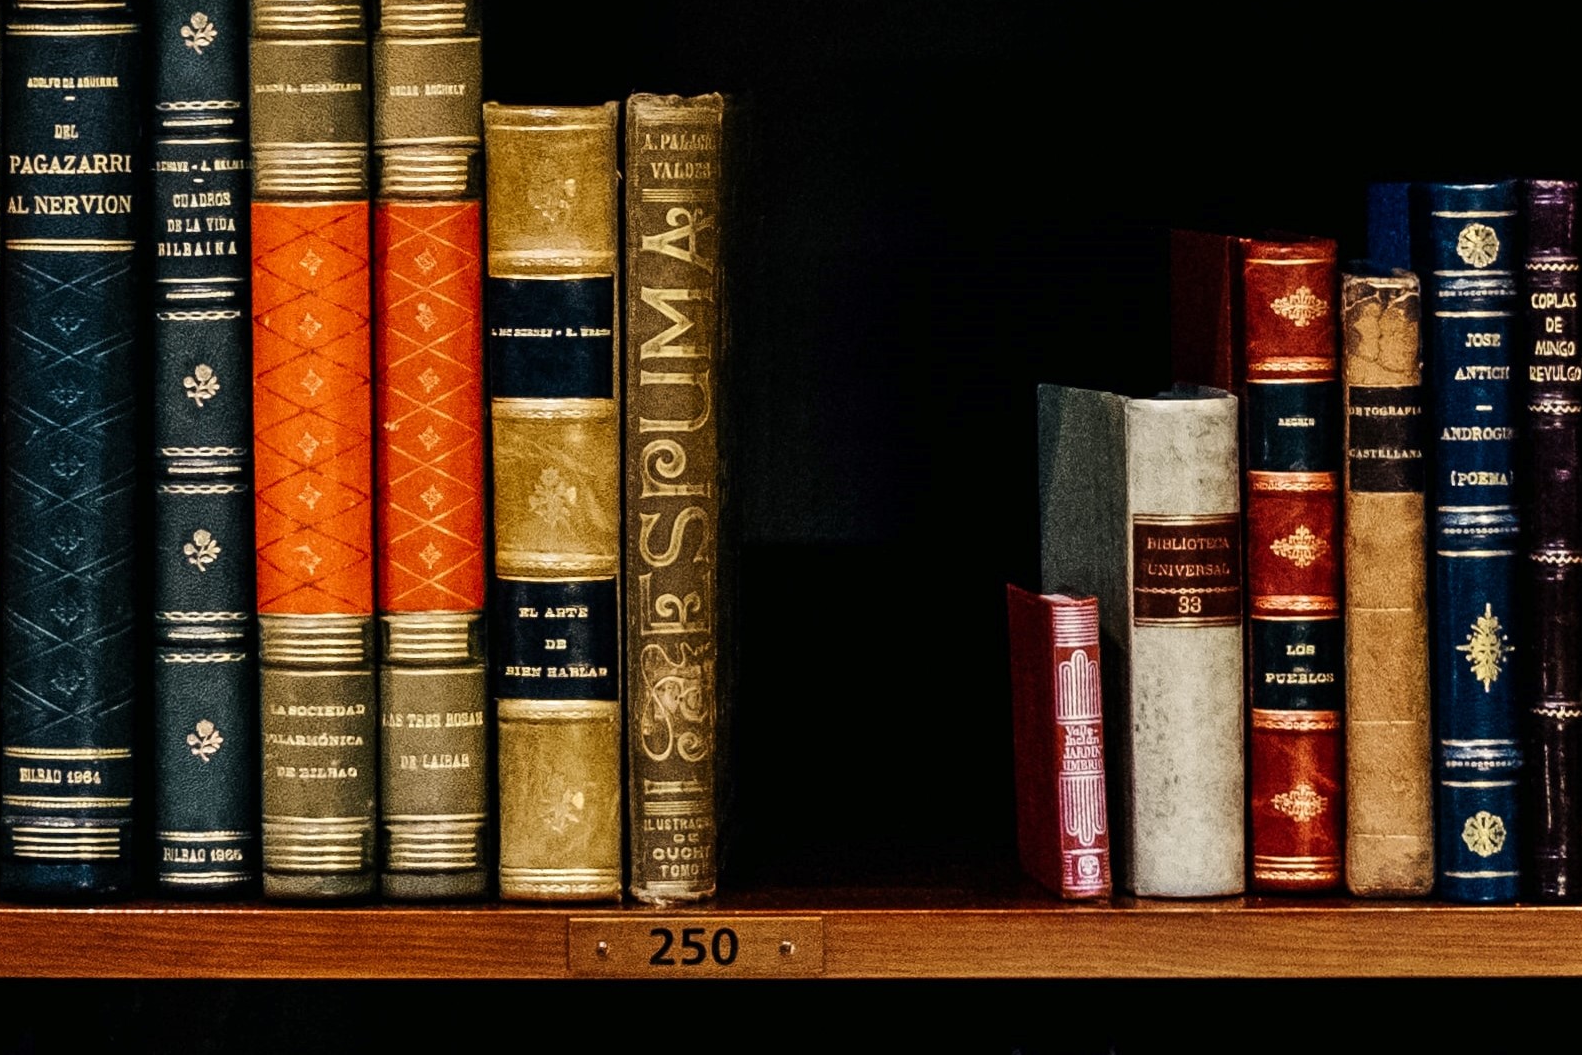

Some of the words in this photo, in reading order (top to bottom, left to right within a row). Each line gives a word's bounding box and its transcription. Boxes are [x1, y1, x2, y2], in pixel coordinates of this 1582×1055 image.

[54, 124, 79, 139] DEL
[9, 153, 132, 175] PAGAZARRI
[7, 196, 29, 214] AL
[33, 195, 132, 214] NERVION
[172, 192, 231, 208] CUADROS
[1530, 292, 1577, 309] COPLAS
[1545, 316, 1563, 334] DE
[1465, 333, 1501, 347] JOSE
[1535, 340, 1576, 357] MINGO
[1529, 365, 1582, 382] REVULGO
[1147, 536, 1230, 550] BIBLIOTECA
[1147, 563, 1230, 577] UNIVERSAL
[1178, 595, 1202, 614] 33
[518, 607, 539, 619] EL
[544, 607, 589, 619] ARTE
[545, 638, 567, 650] DE
[1286, 643, 1316, 656] LOS
[1265, 672, 1335, 684] PUEBLOS
[649, 927, 740, 967] 250
